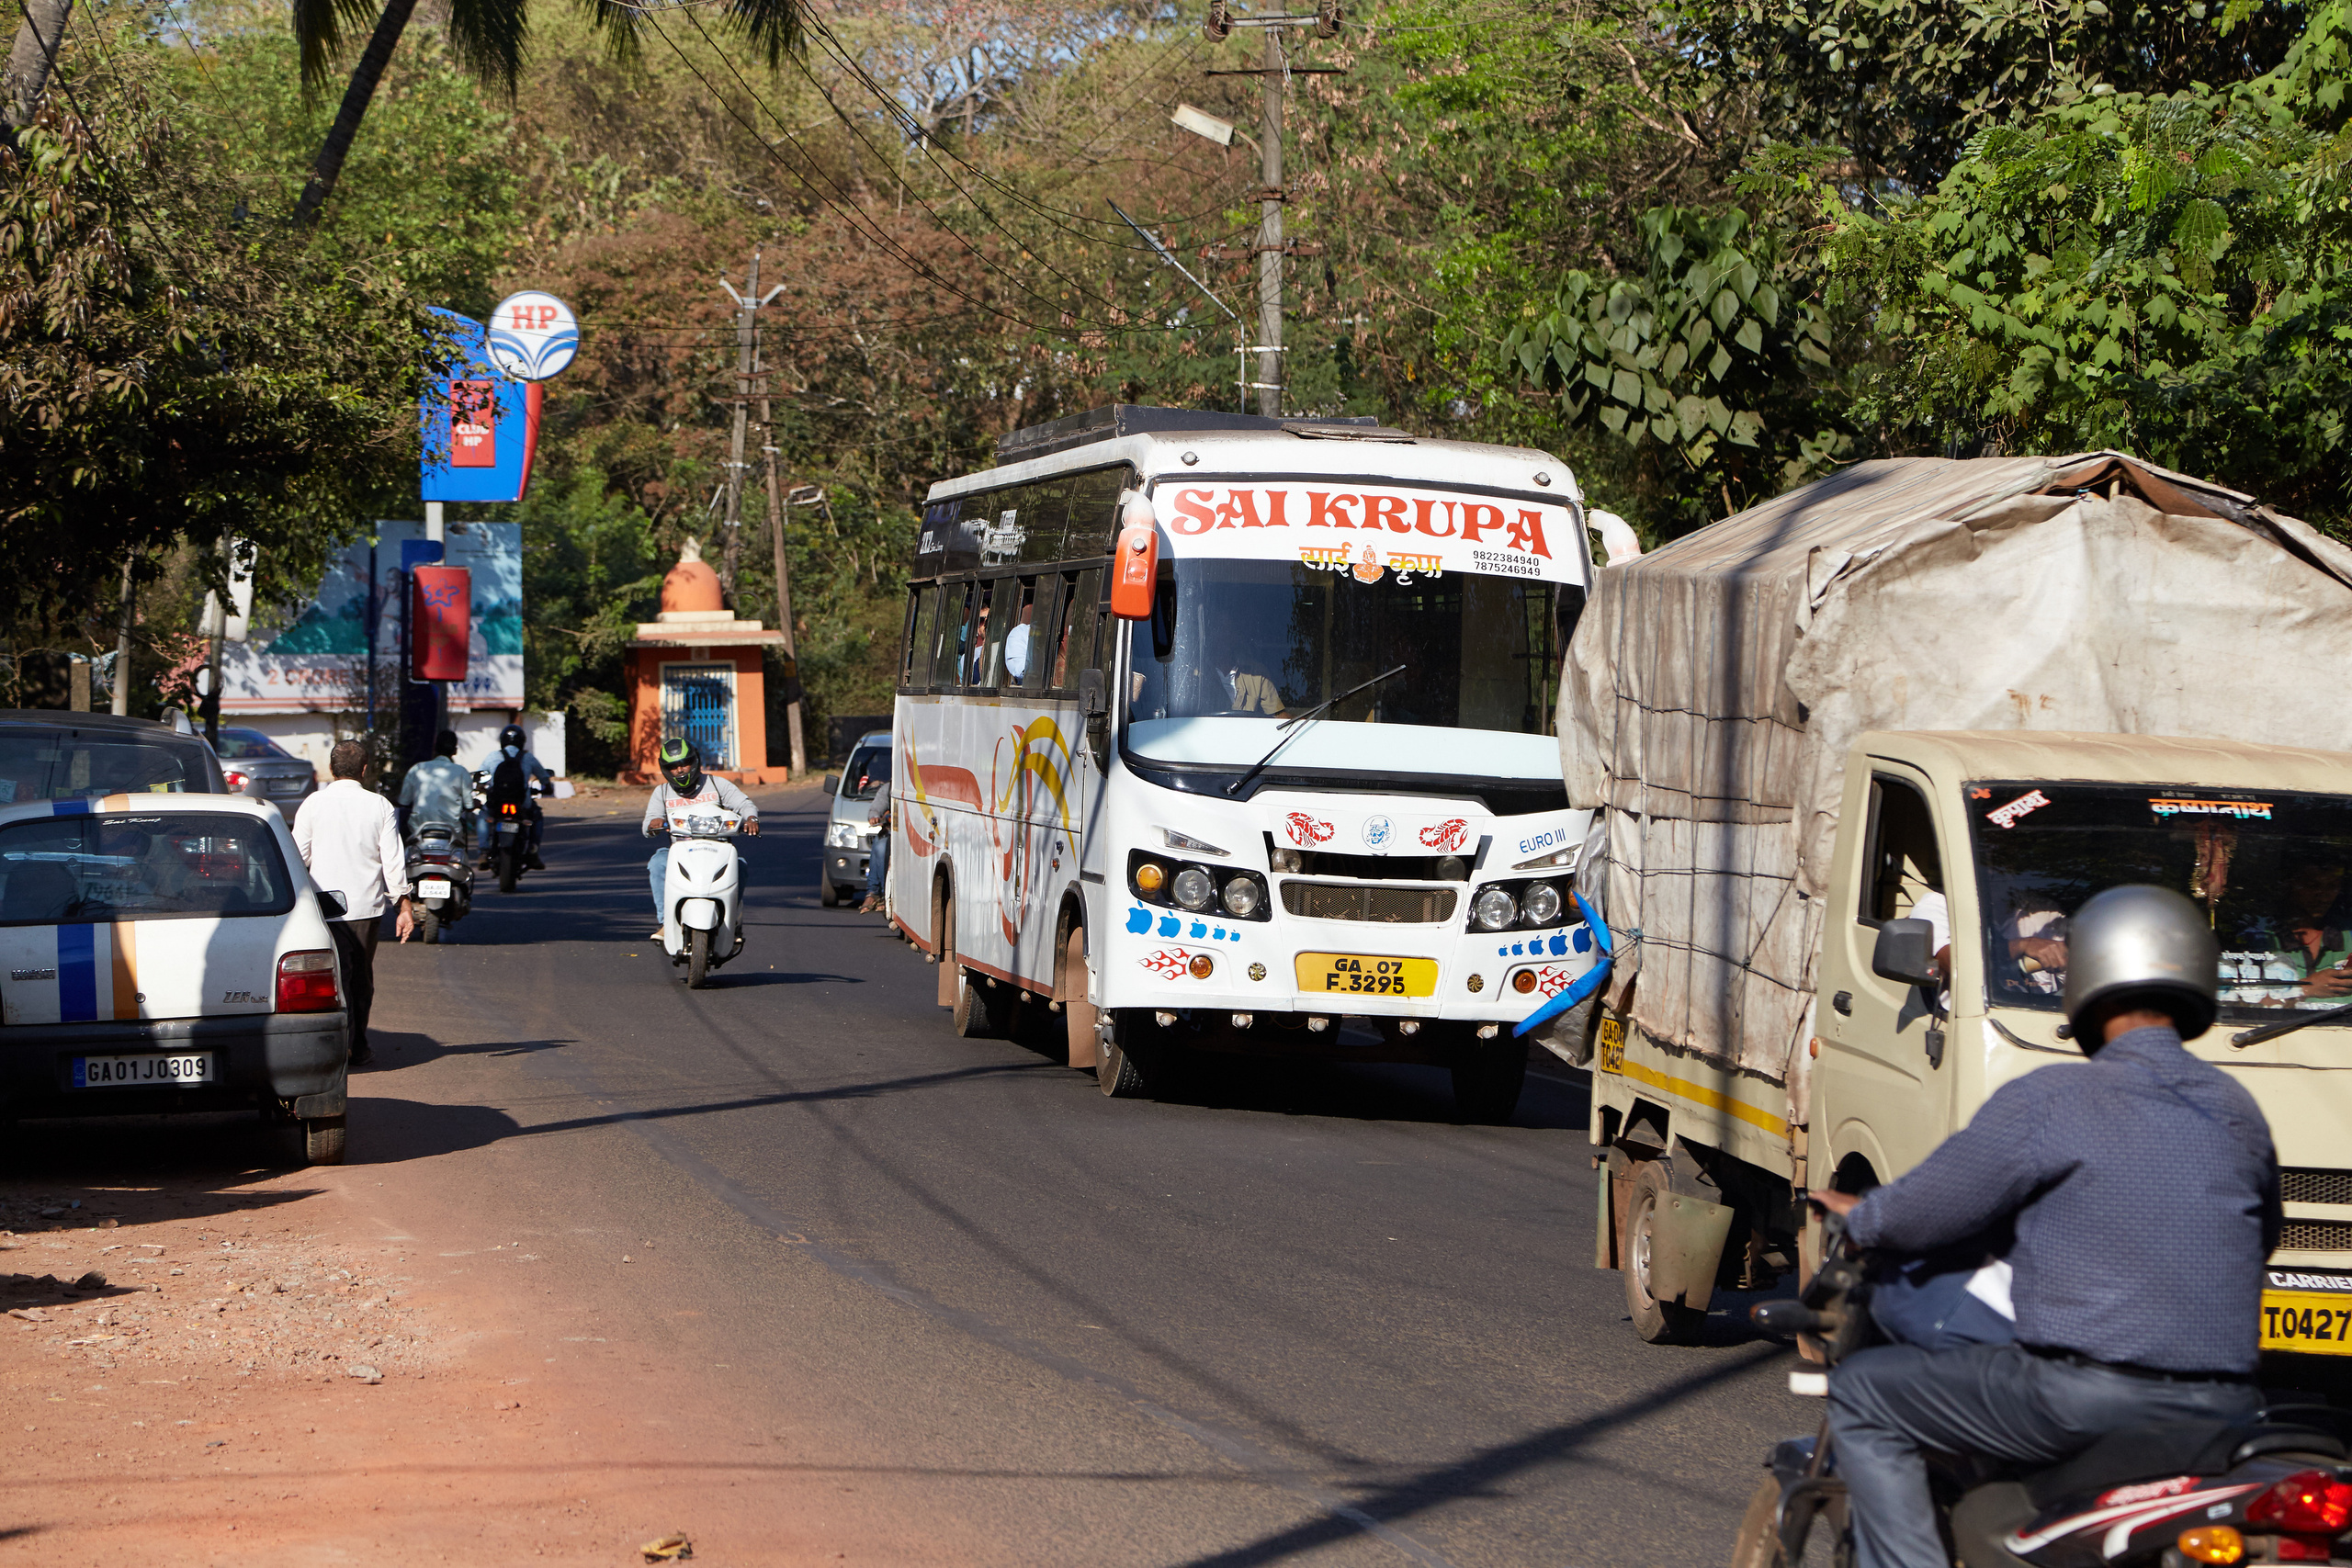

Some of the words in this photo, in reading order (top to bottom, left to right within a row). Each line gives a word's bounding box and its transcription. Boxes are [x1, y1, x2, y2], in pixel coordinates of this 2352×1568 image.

[511, 306, 558, 329] HP
[464, 435, 482, 446] HP
[1170, 489, 1290, 536] SAI
[1306, 491, 1553, 560] KRUPA
[1299, 541, 1352, 578] साई
[1386, 551, 1443, 586] कृपा
[1473, 550, 1540, 567] 9822384940
[1474, 561, 1541, 577] 7875246949
[267, 670, 278, 685] 2
[285, 669, 351, 685] CRORE
[665, 792, 718, 809] CLASSIC
[1519, 832, 1554, 853] EURO
[223, 990, 251, 1003] ZEN
